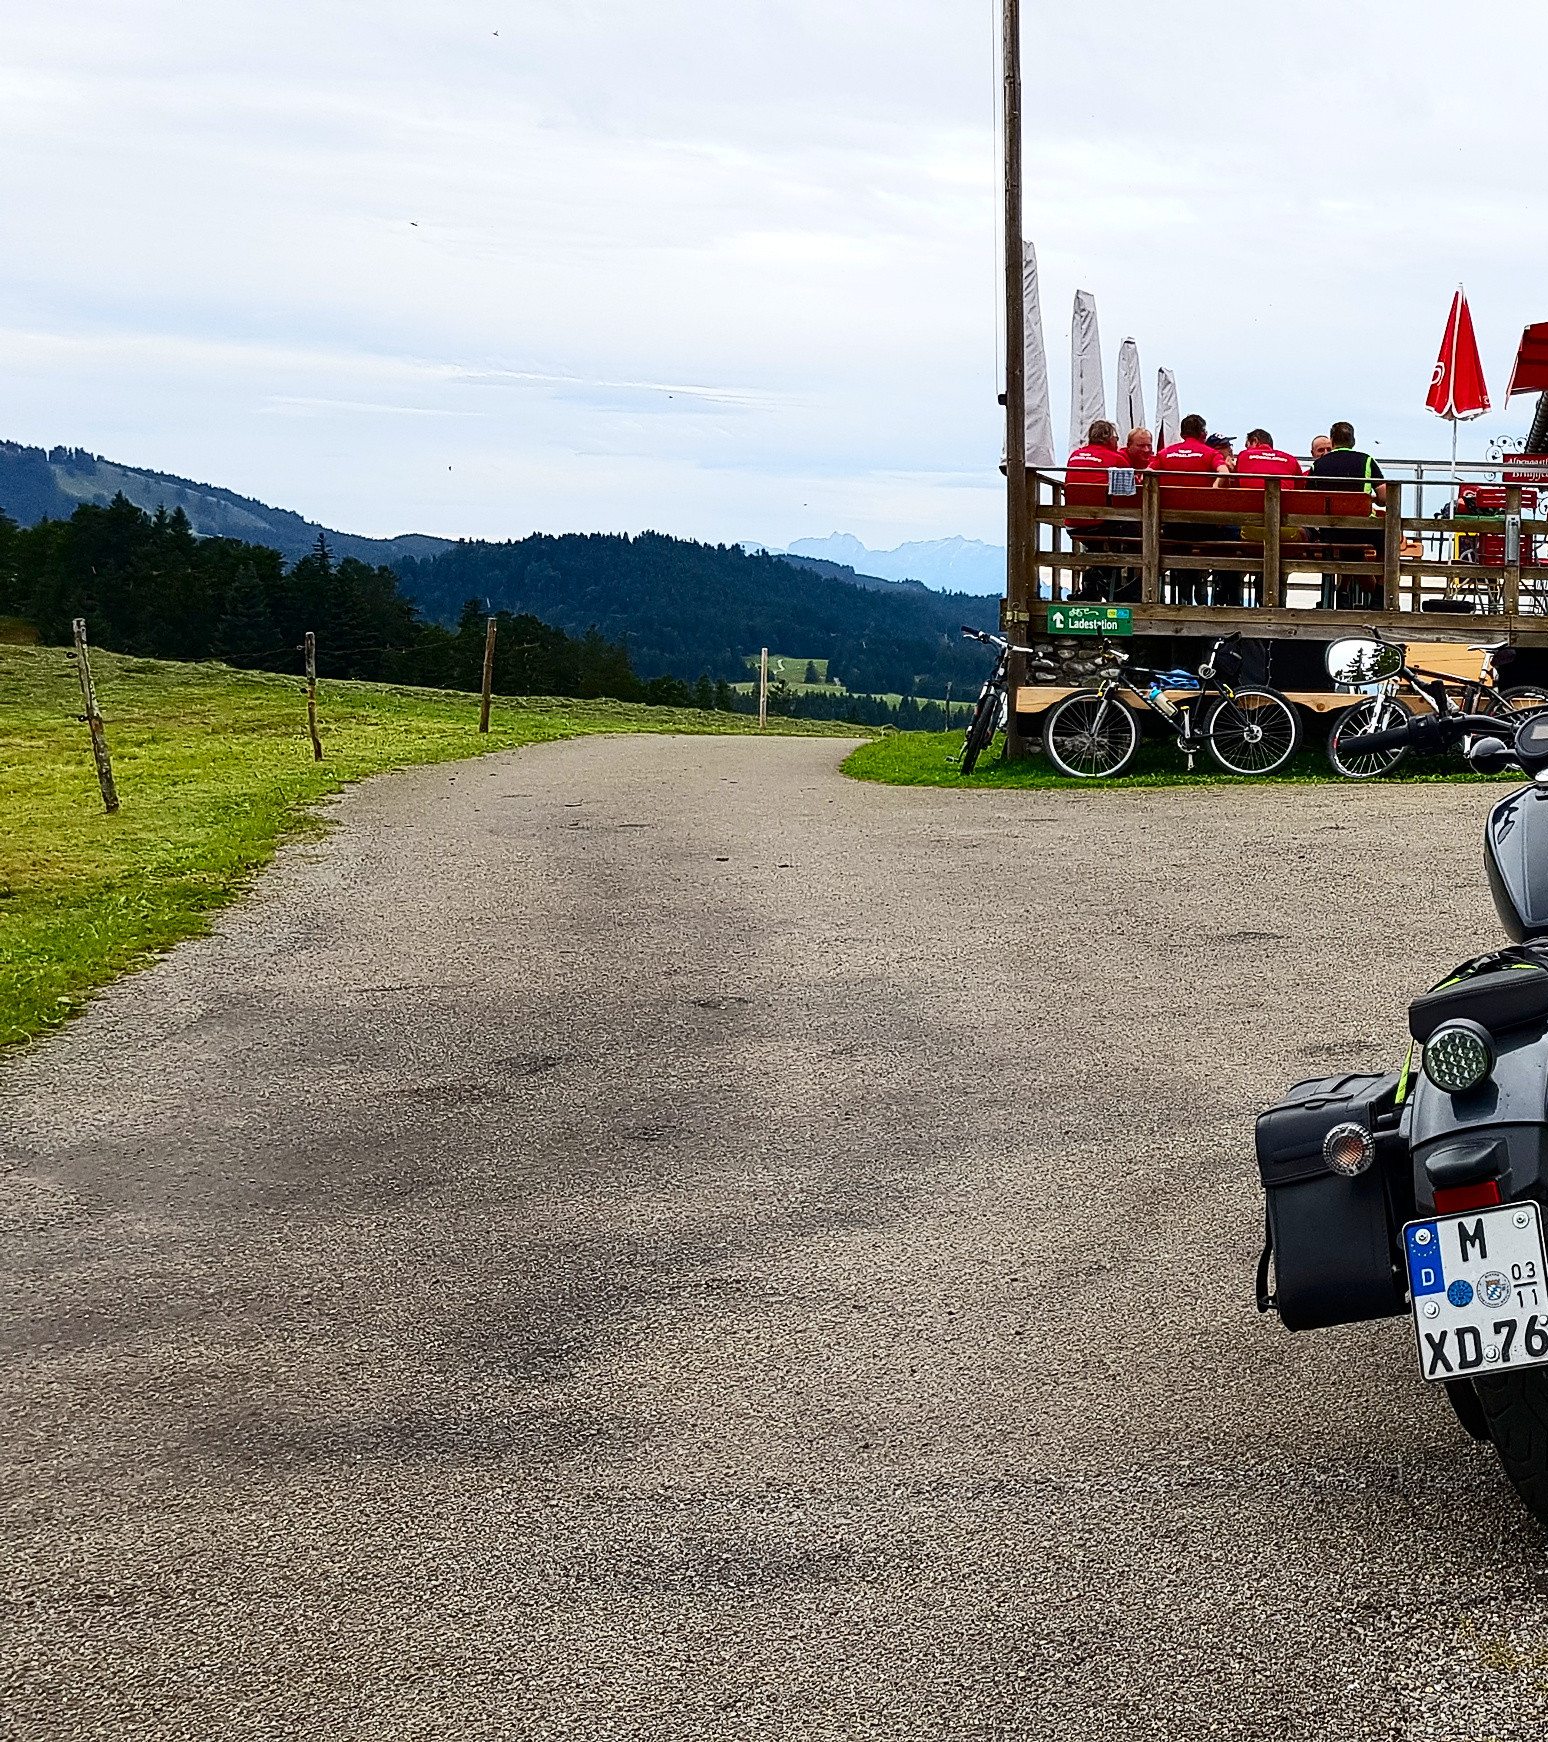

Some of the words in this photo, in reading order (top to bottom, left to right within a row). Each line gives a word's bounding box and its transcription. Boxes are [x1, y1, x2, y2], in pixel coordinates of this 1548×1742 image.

[1457, 1217, 1488, 1262] M
[1421, 1268, 1435, 1287] D
[1511, 1261, 1536, 1281] 03
[1516, 1288, 1538, 1308] 11
